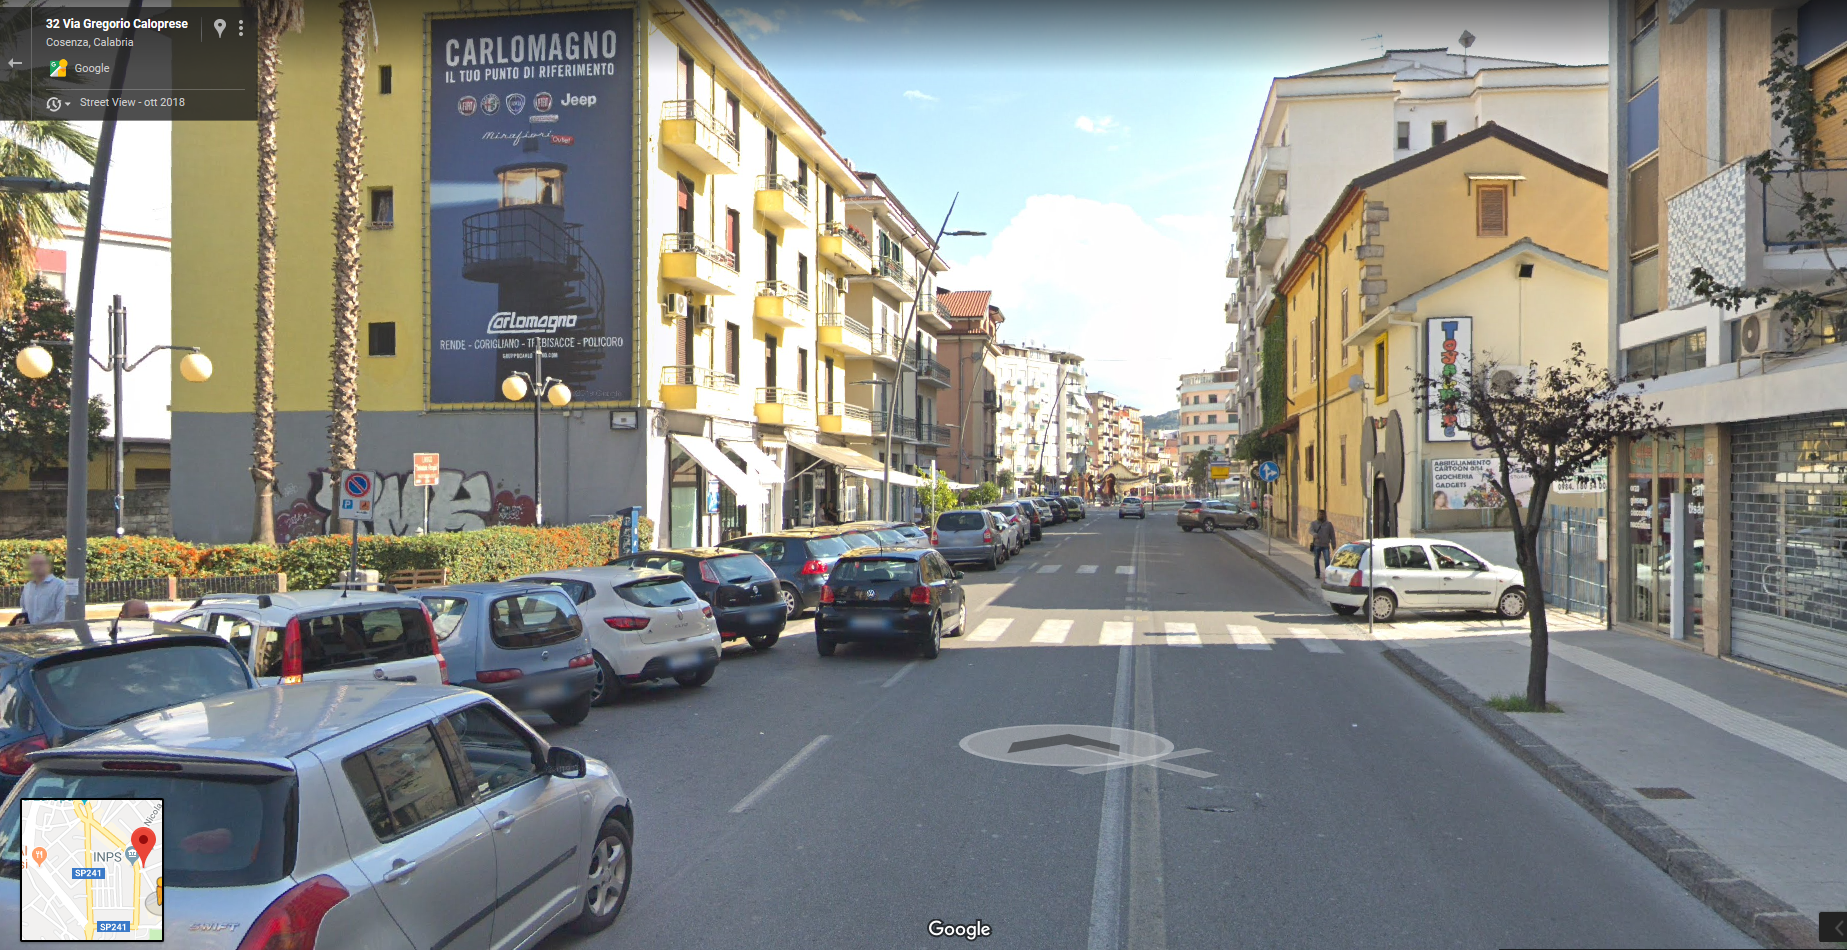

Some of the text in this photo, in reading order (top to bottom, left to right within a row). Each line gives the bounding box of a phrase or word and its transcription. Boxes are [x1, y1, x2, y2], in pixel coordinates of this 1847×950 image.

[445, 29, 617, 67] CARLOMAGNO
[445, 63, 615, 83] IL TUO PUNTO DI RIFERIMENTO
[560, 93, 597, 108] Jeep
[487, 312, 577, 334] Carlomagno
[440, 339, 466, 350] RENDE
[474, 339, 520, 349] CORIGLIANO
[583, 336, 624, 347] POLICORO
[189, 922, 241, 932] SWIFT
